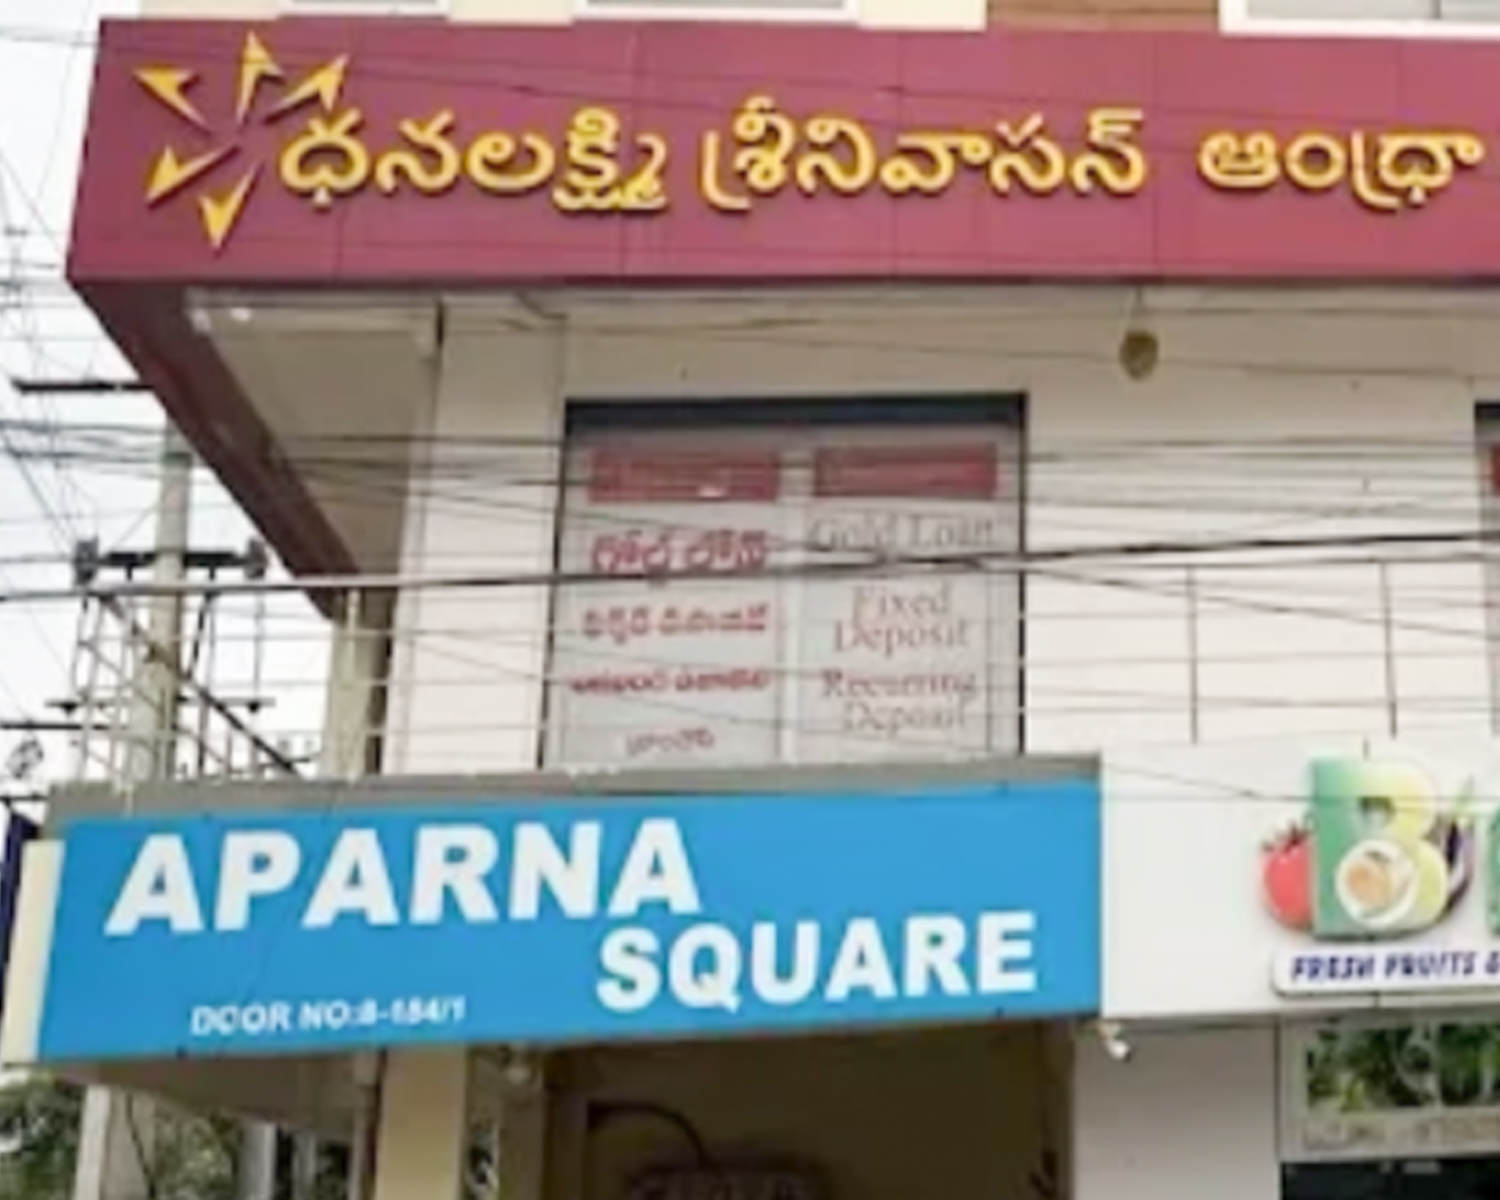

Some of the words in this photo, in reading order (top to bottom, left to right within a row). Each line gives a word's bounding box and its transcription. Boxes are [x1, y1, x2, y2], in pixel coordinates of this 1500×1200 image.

[279, 106, 669, 213] ధనలక్ష్మి
[700, 96, 1148, 213] శ్రీనివాసన్
[1197, 129, 1484, 212] ఆంధ్రా
[105, 819, 702, 936] APARNA
[596, 910, 1038, 1014] SQUARE
[1290, 953, 1376, 985] FRESH
[1383, 950, 1476, 981] FRUITS
